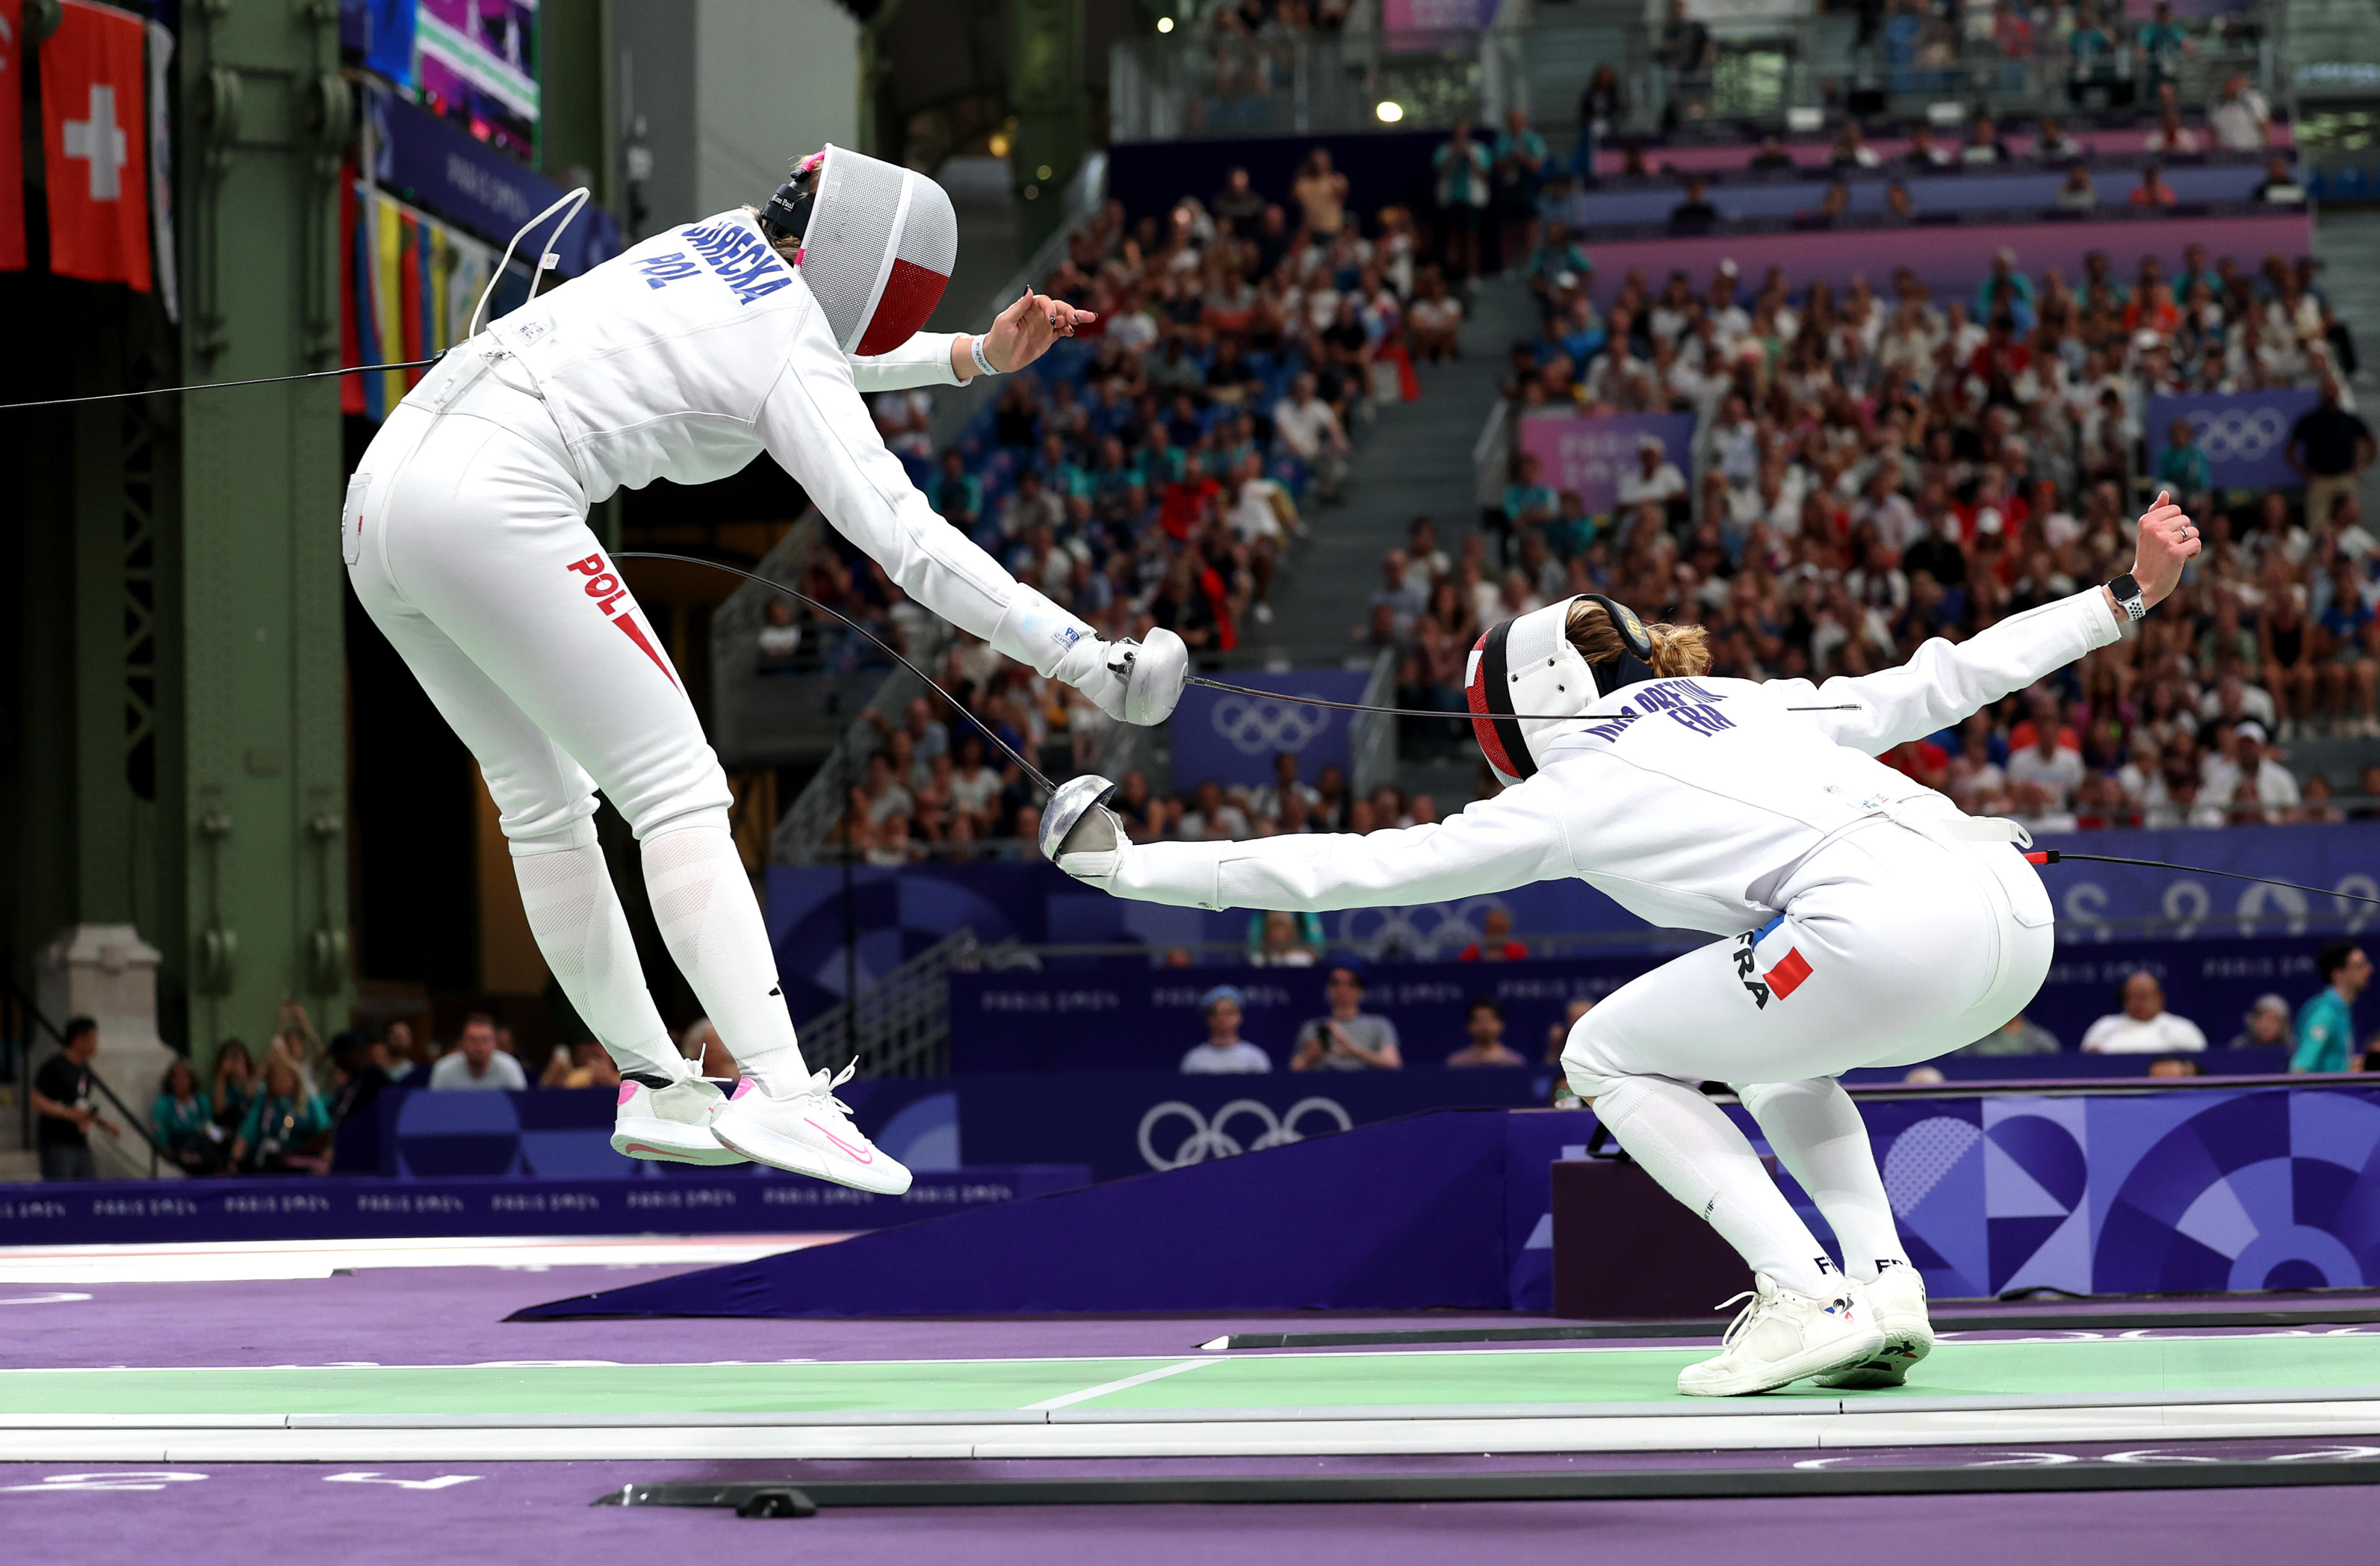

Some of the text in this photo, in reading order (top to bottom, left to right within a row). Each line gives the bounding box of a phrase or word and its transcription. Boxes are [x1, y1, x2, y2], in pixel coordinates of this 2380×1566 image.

[782, 199, 794, 210] Paul
[629, 252, 702, 290] POL
[566, 553, 627, 616] POL
[1667, 704, 1737, 737] FRA
[1733, 931, 1770, 1011] FRA
